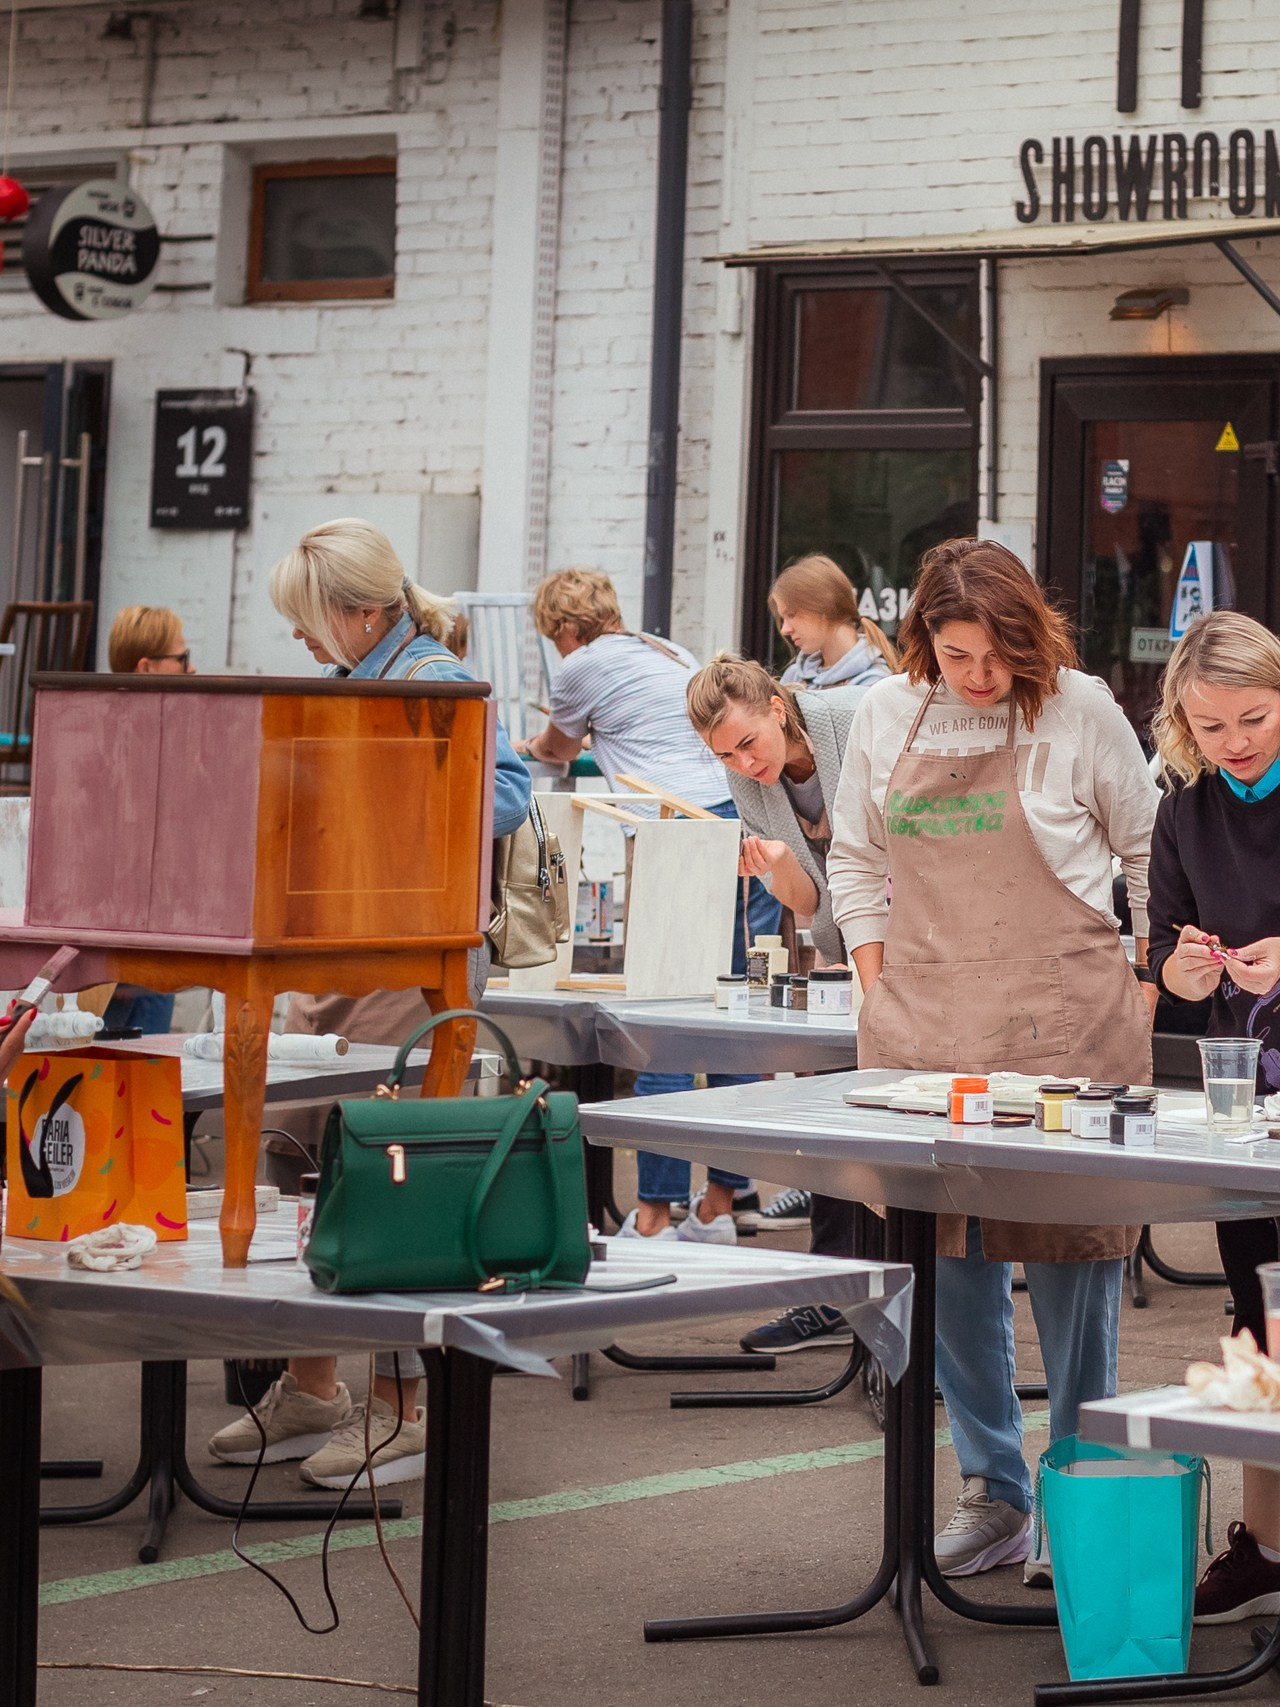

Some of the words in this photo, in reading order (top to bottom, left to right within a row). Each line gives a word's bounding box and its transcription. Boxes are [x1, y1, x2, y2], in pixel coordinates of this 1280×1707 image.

[78, 225, 136, 251] SILVER
[77, 249, 138, 275] PANDA
[175, 425, 227, 478] 12
[929, 721, 949, 736] WE
[951, 717, 974, 731] ARE
[978, 716, 1010, 730] GOIN
[43, 1142, 74, 1166] EILER
